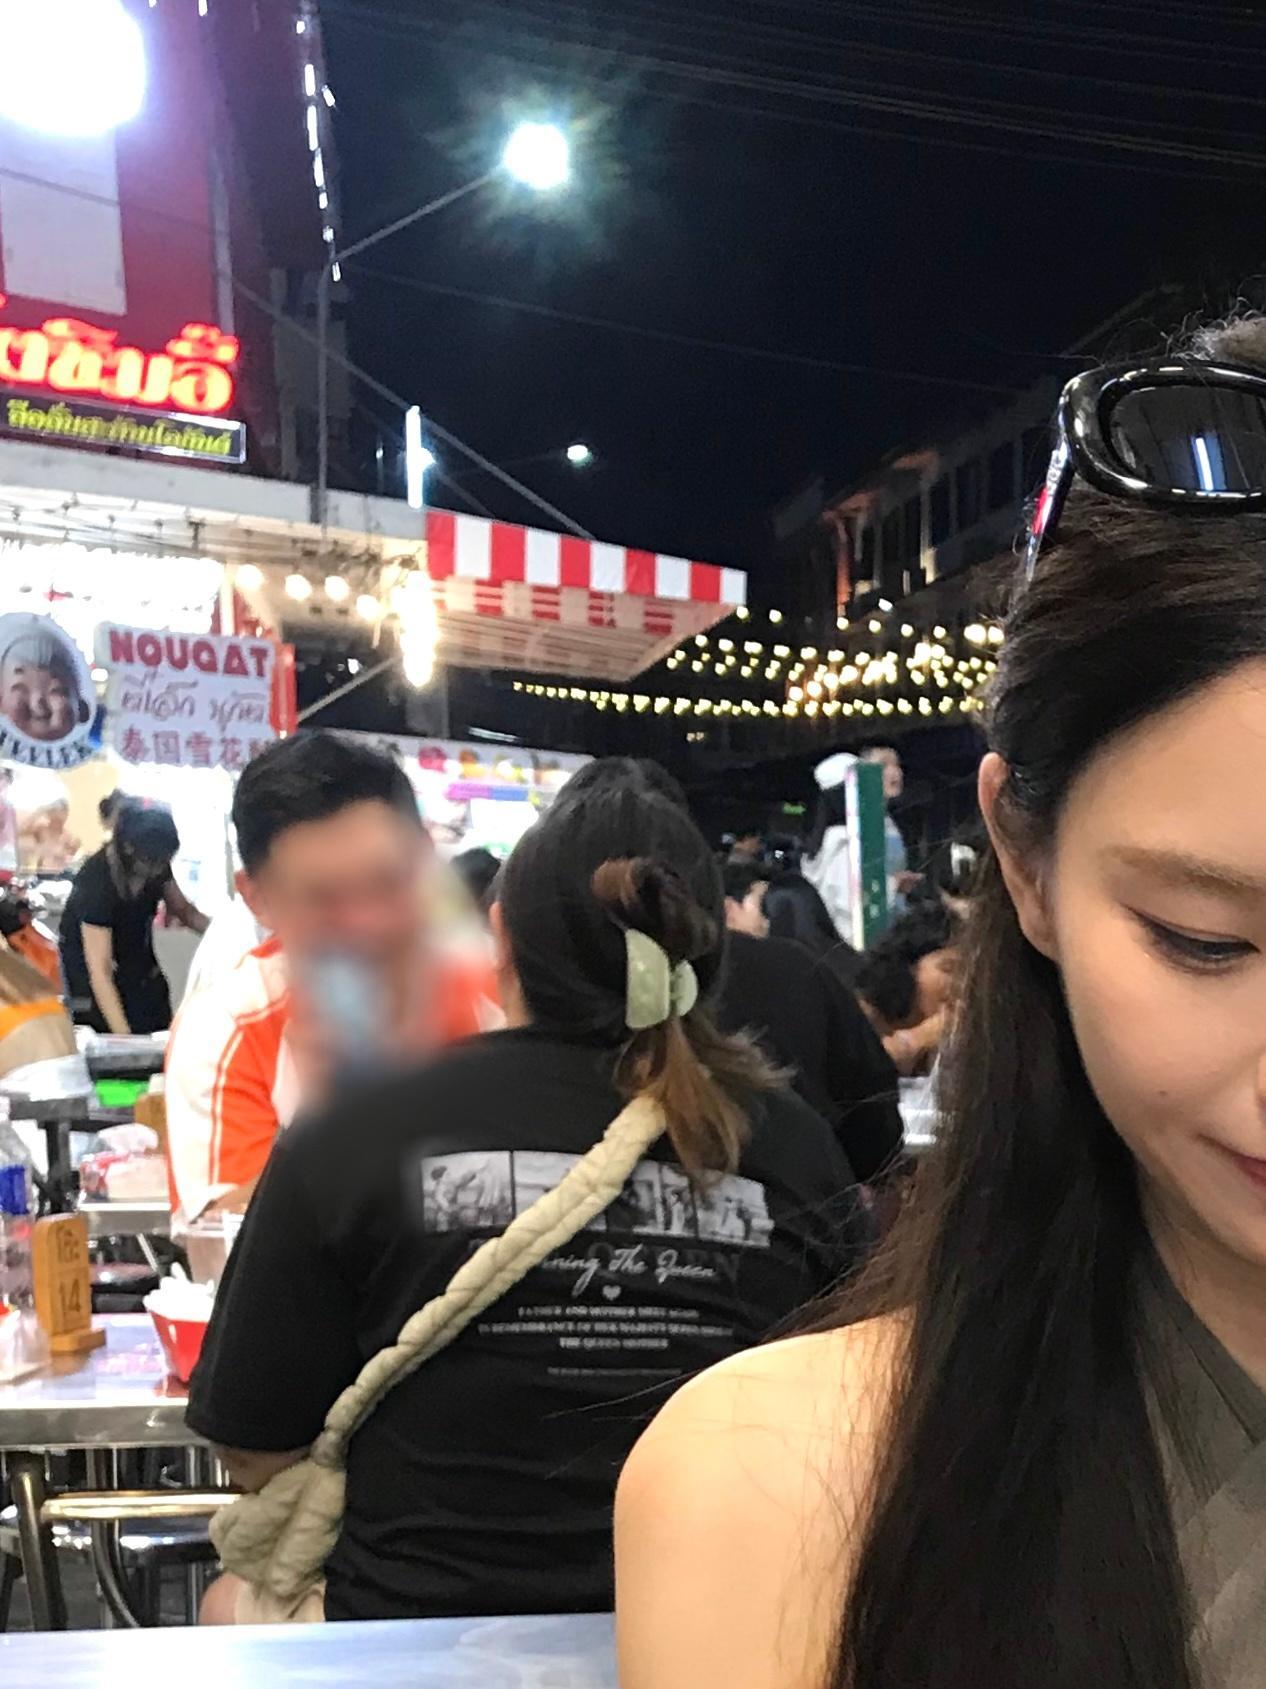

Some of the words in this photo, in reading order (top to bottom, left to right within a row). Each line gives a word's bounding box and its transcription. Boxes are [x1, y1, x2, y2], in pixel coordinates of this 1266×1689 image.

[122, 724, 269, 768] 泰国雪花
[608, 1244, 648, 1275] The
[59, 1279, 82, 1312] 14
